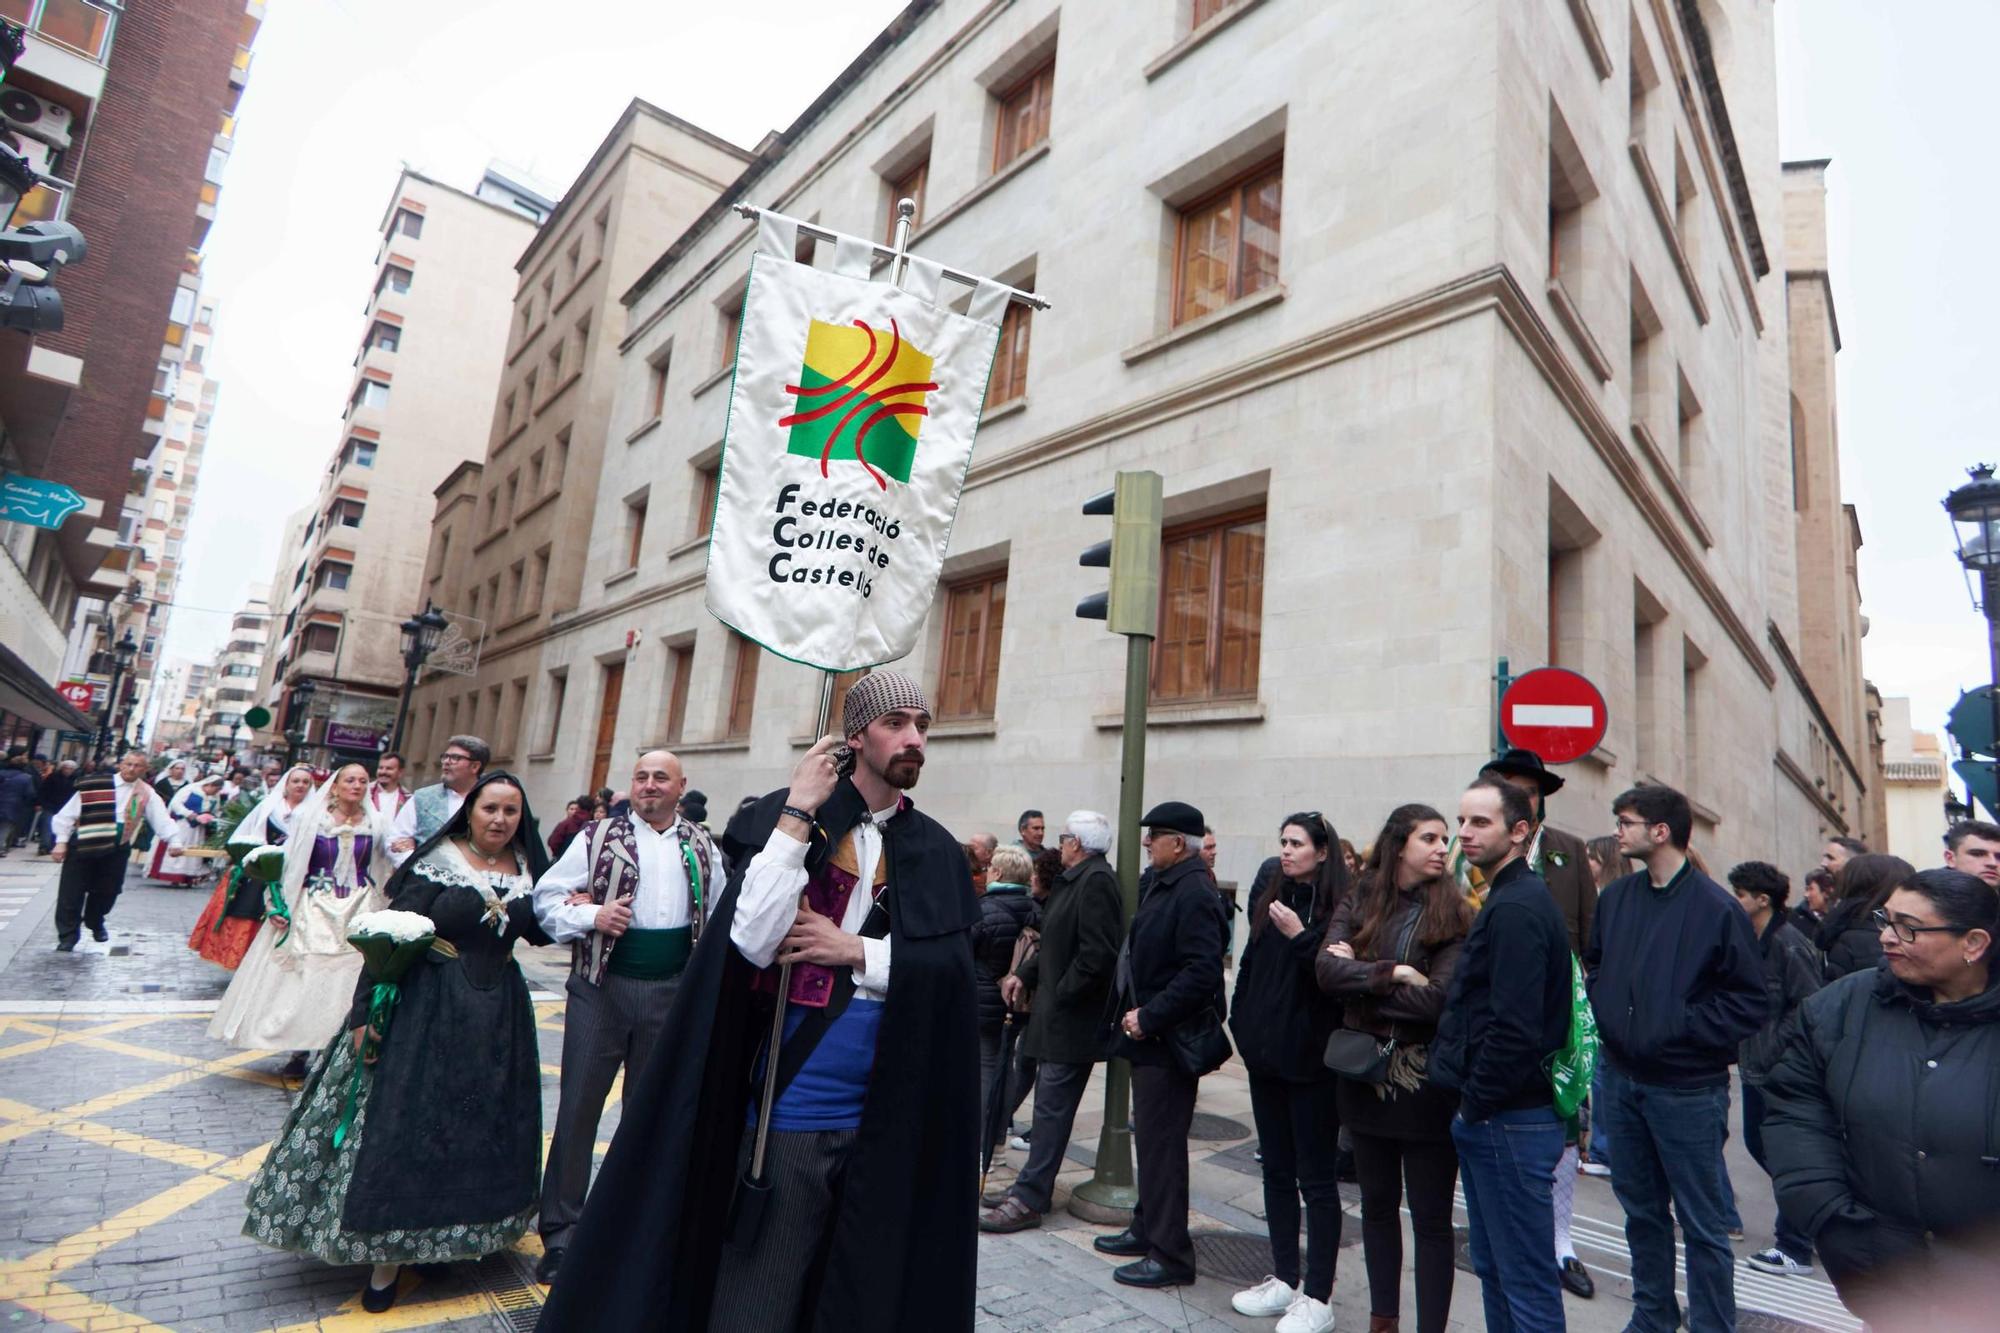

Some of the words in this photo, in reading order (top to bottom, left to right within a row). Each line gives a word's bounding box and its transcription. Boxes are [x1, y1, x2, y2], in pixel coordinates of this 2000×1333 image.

[776, 484, 900, 539] Federació
[773, 516, 865, 553] Colles
[868, 545, 889, 568] de
[768, 552, 872, 598] Castelló
